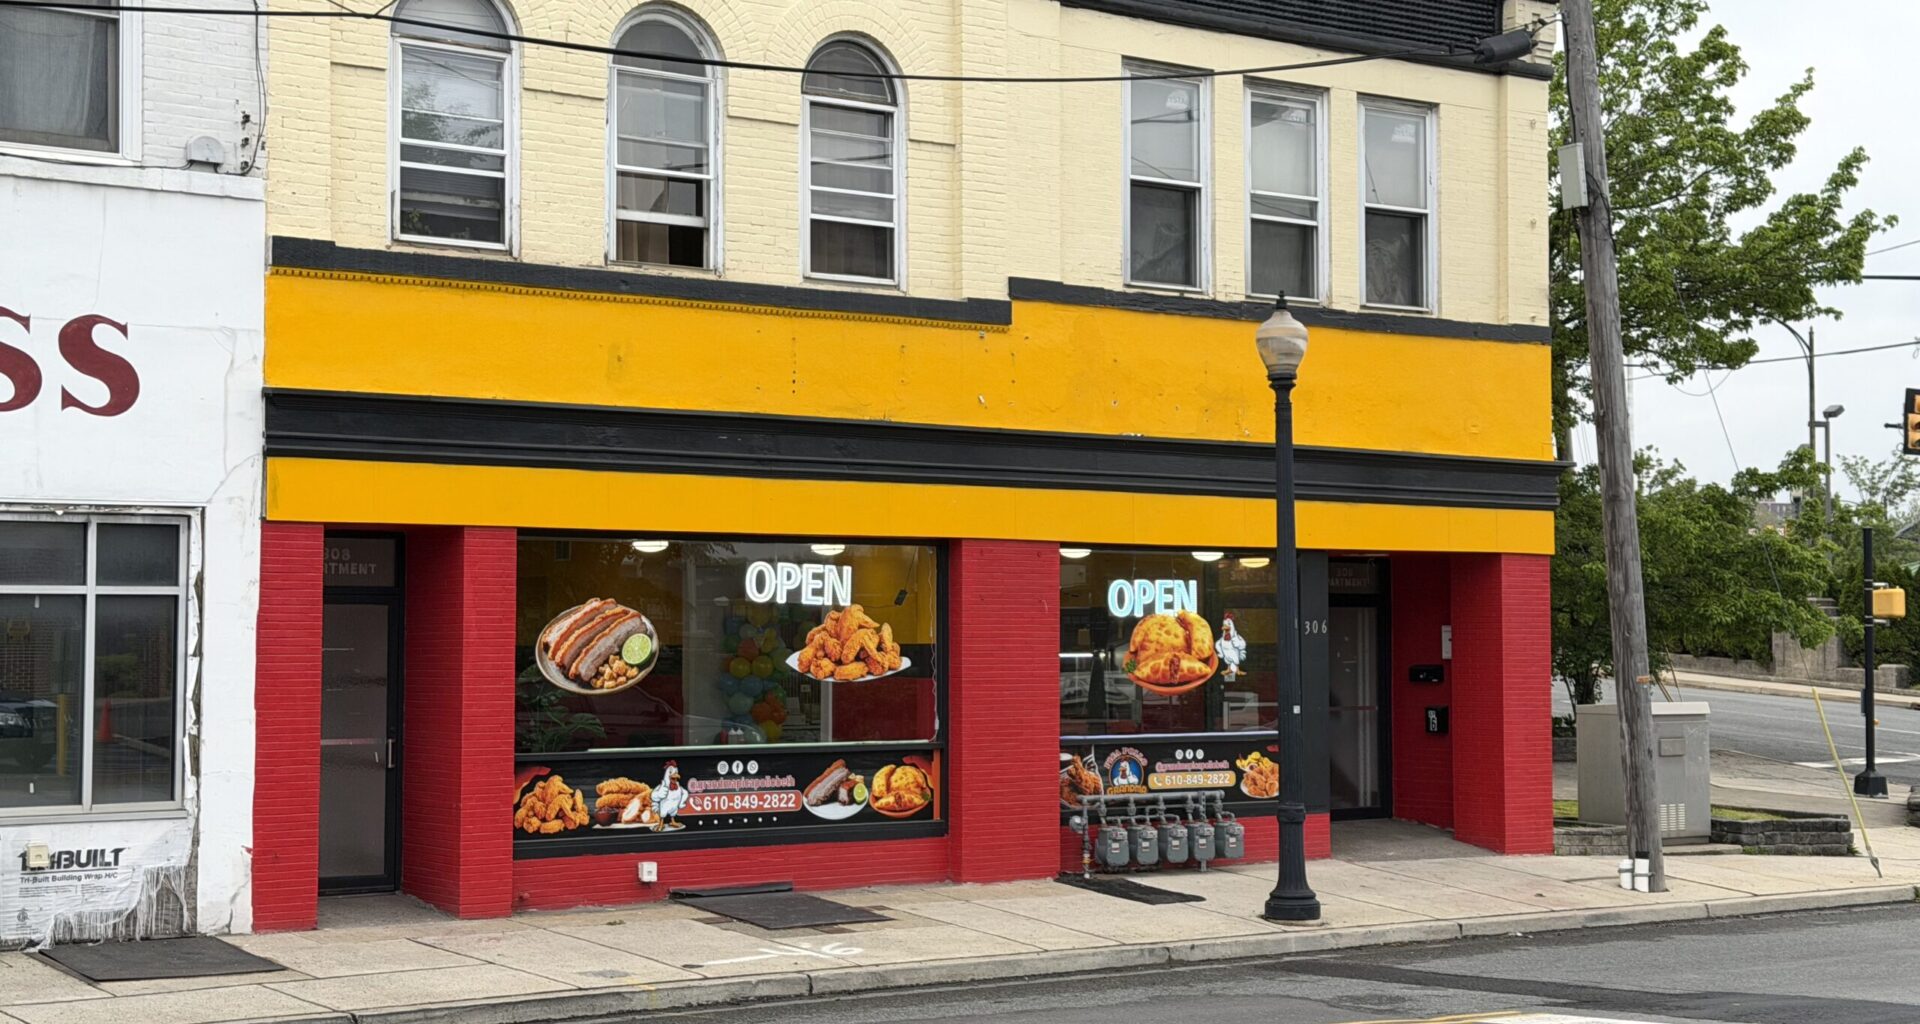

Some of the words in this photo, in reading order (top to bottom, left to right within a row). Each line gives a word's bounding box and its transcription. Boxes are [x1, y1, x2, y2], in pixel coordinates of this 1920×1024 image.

[745, 561, 852, 606] OPEN
[1107, 578, 1198, 618] OPEN
[1304, 619, 1328, 635] 306
[1165, 773, 1230, 786] 610-849-2822
[703, 793, 796, 811] 610-849-2822
[51, 874, 82, 882] Building
[84, 872, 103, 880] Wrap
